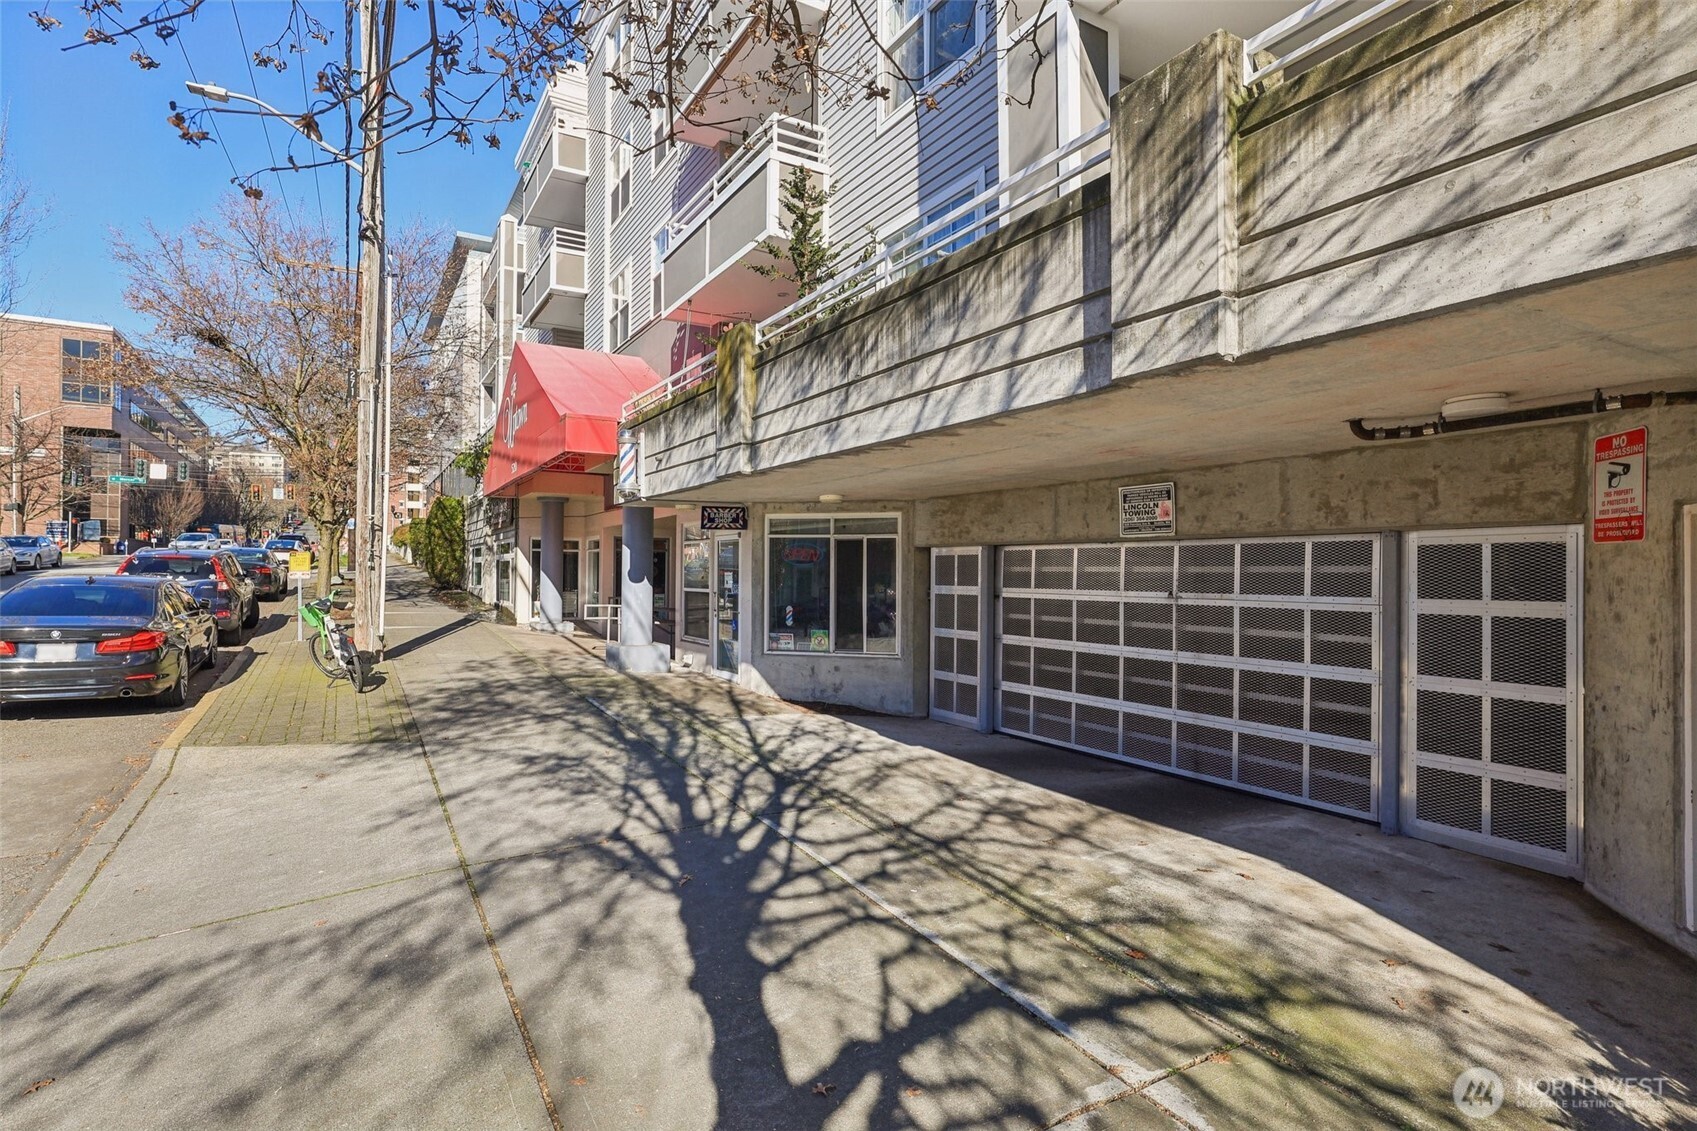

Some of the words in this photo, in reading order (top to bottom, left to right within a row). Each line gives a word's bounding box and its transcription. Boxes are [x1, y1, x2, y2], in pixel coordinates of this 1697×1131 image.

[1612, 435, 1628, 449] NO
[1596, 443, 1644, 460] TRESPASSING
[1613, 488, 1634, 497] PROPERTY
[1123, 502, 1159, 510] LINCOLN
[1607, 498, 1629, 506] PROTECTED
[1123, 509, 1156, 517] TOWING
[1595, 520, 1628, 529] TRESPASSERS
